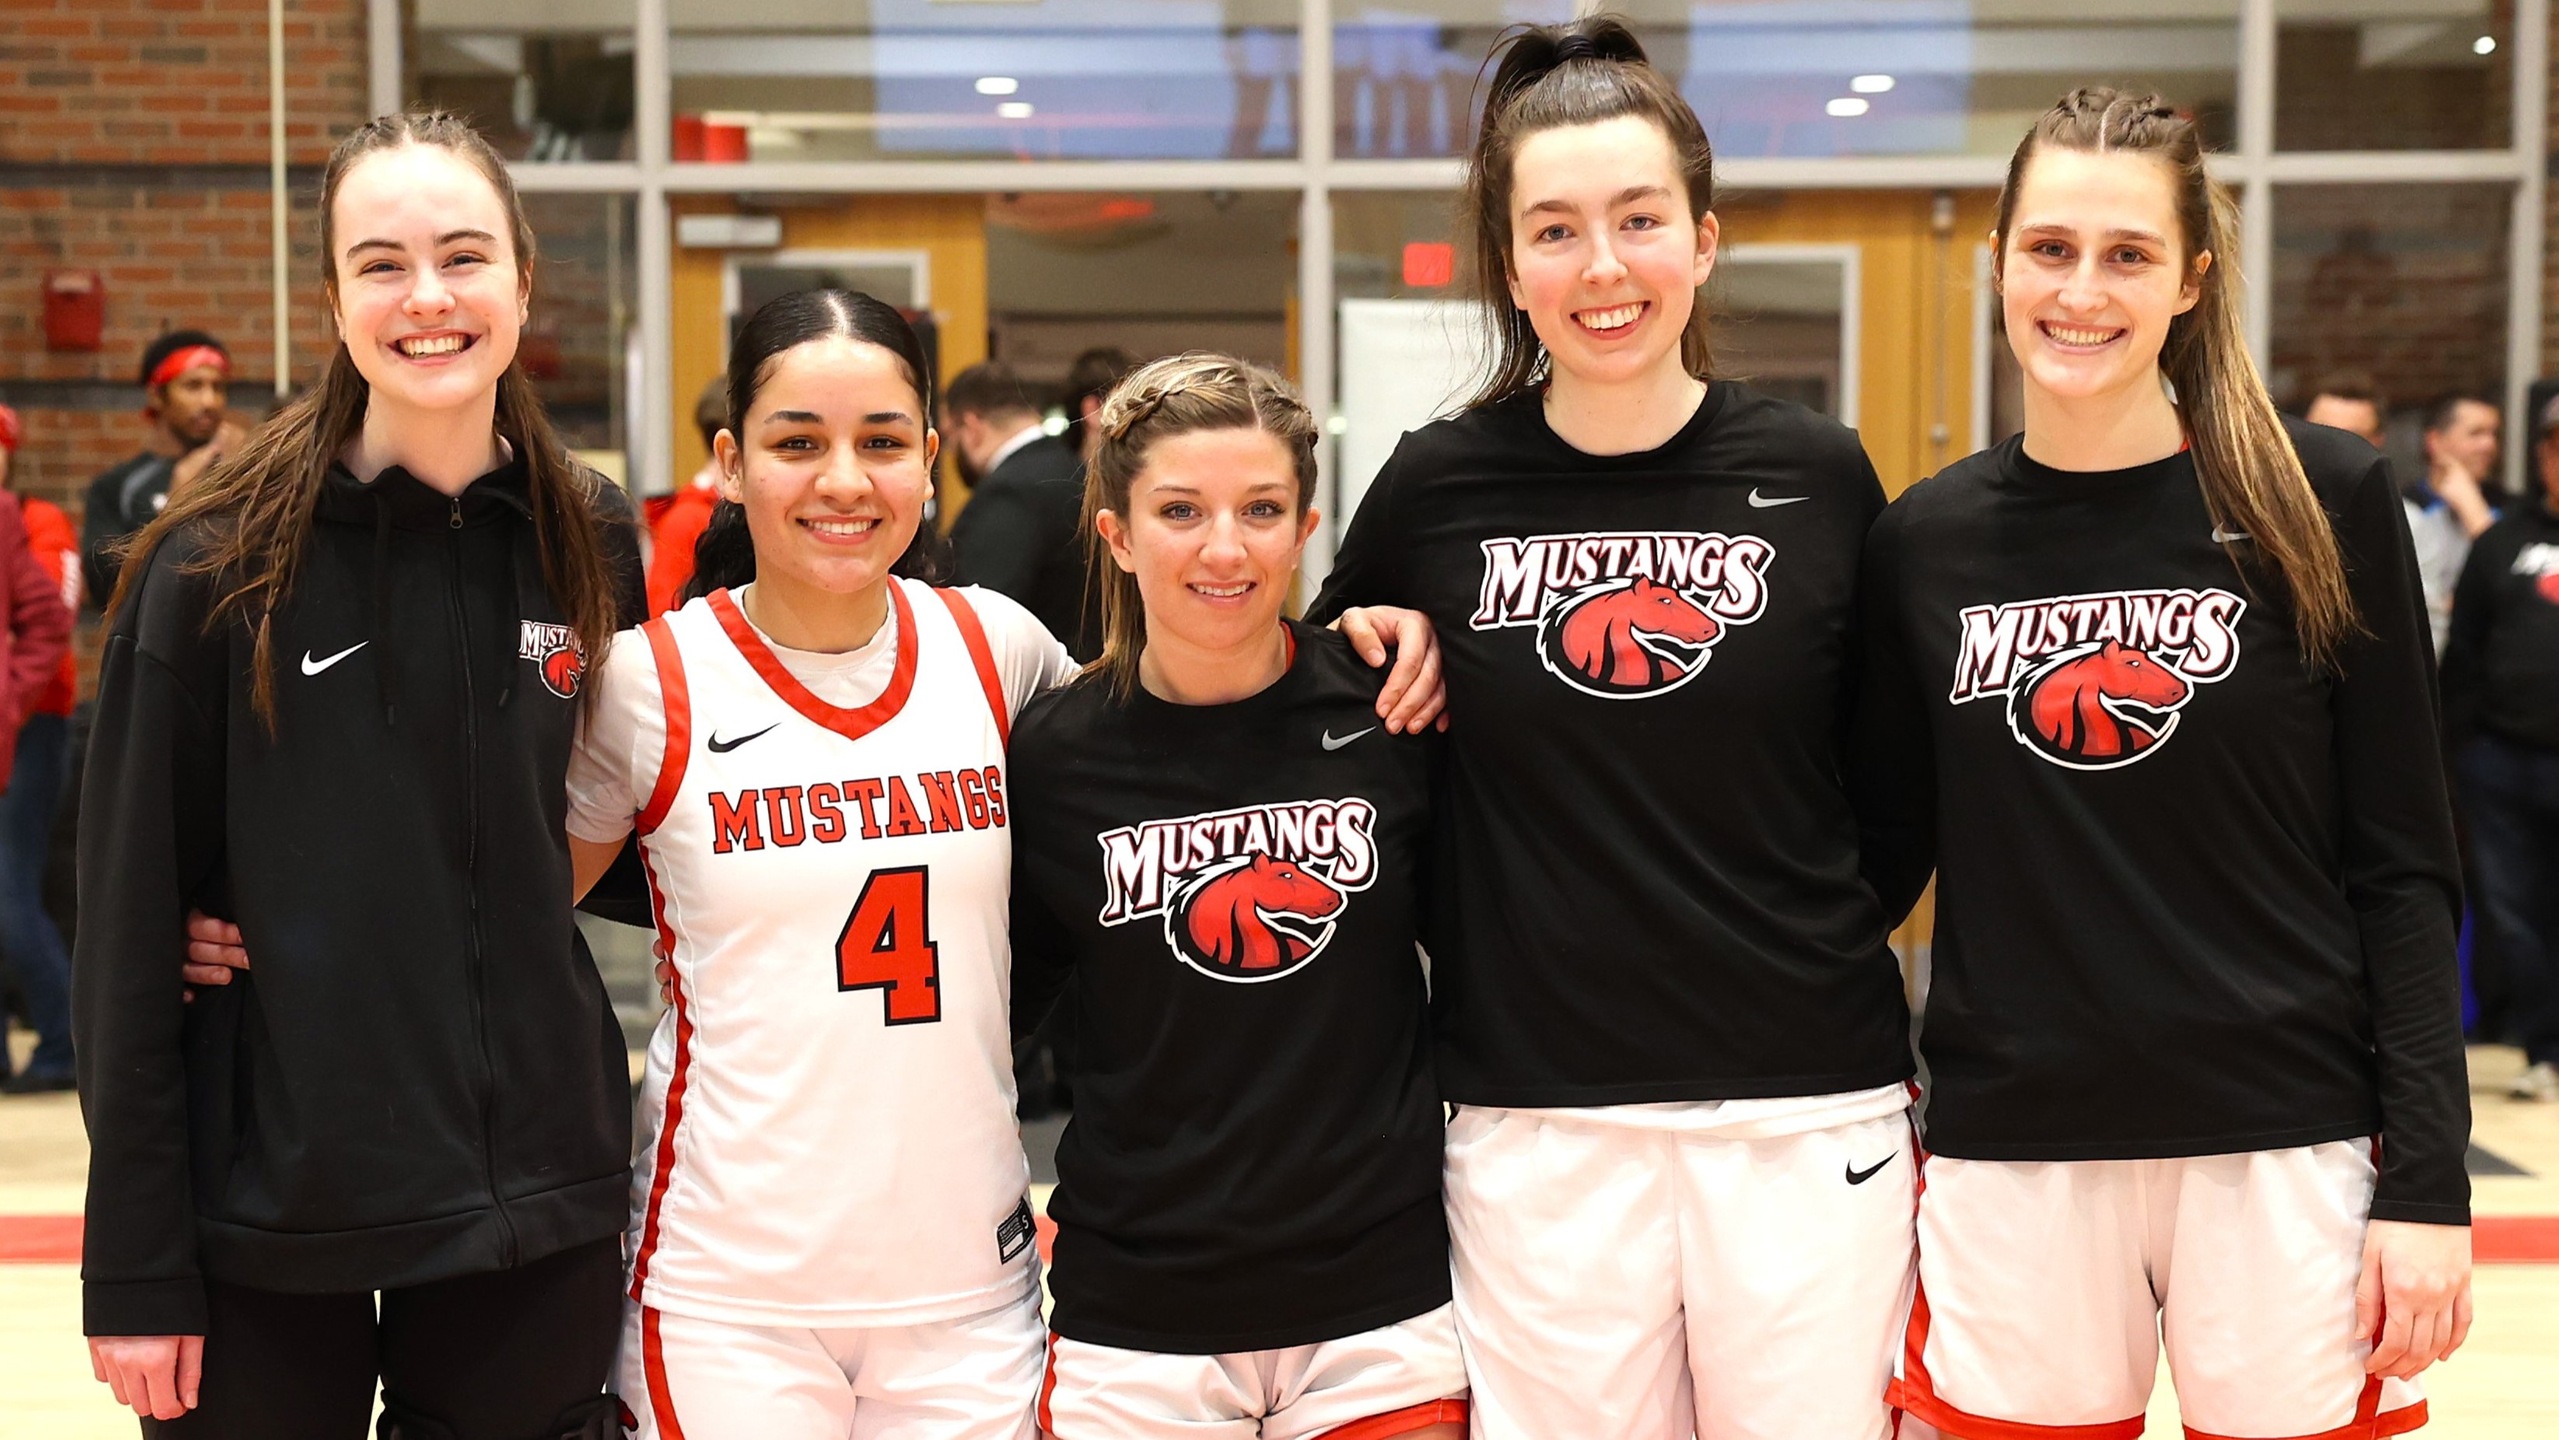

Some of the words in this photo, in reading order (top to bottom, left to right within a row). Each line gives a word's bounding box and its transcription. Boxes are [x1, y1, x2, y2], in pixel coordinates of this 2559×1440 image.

[1477, 536, 1768, 624] MUSTANGS
[1955, 592, 2238, 698] MUSTANGS
[708, 765, 1006, 854] MUSTANGS
[1103, 801, 1372, 919] MUSTANGS
[835, 864, 941, 1026] 4
